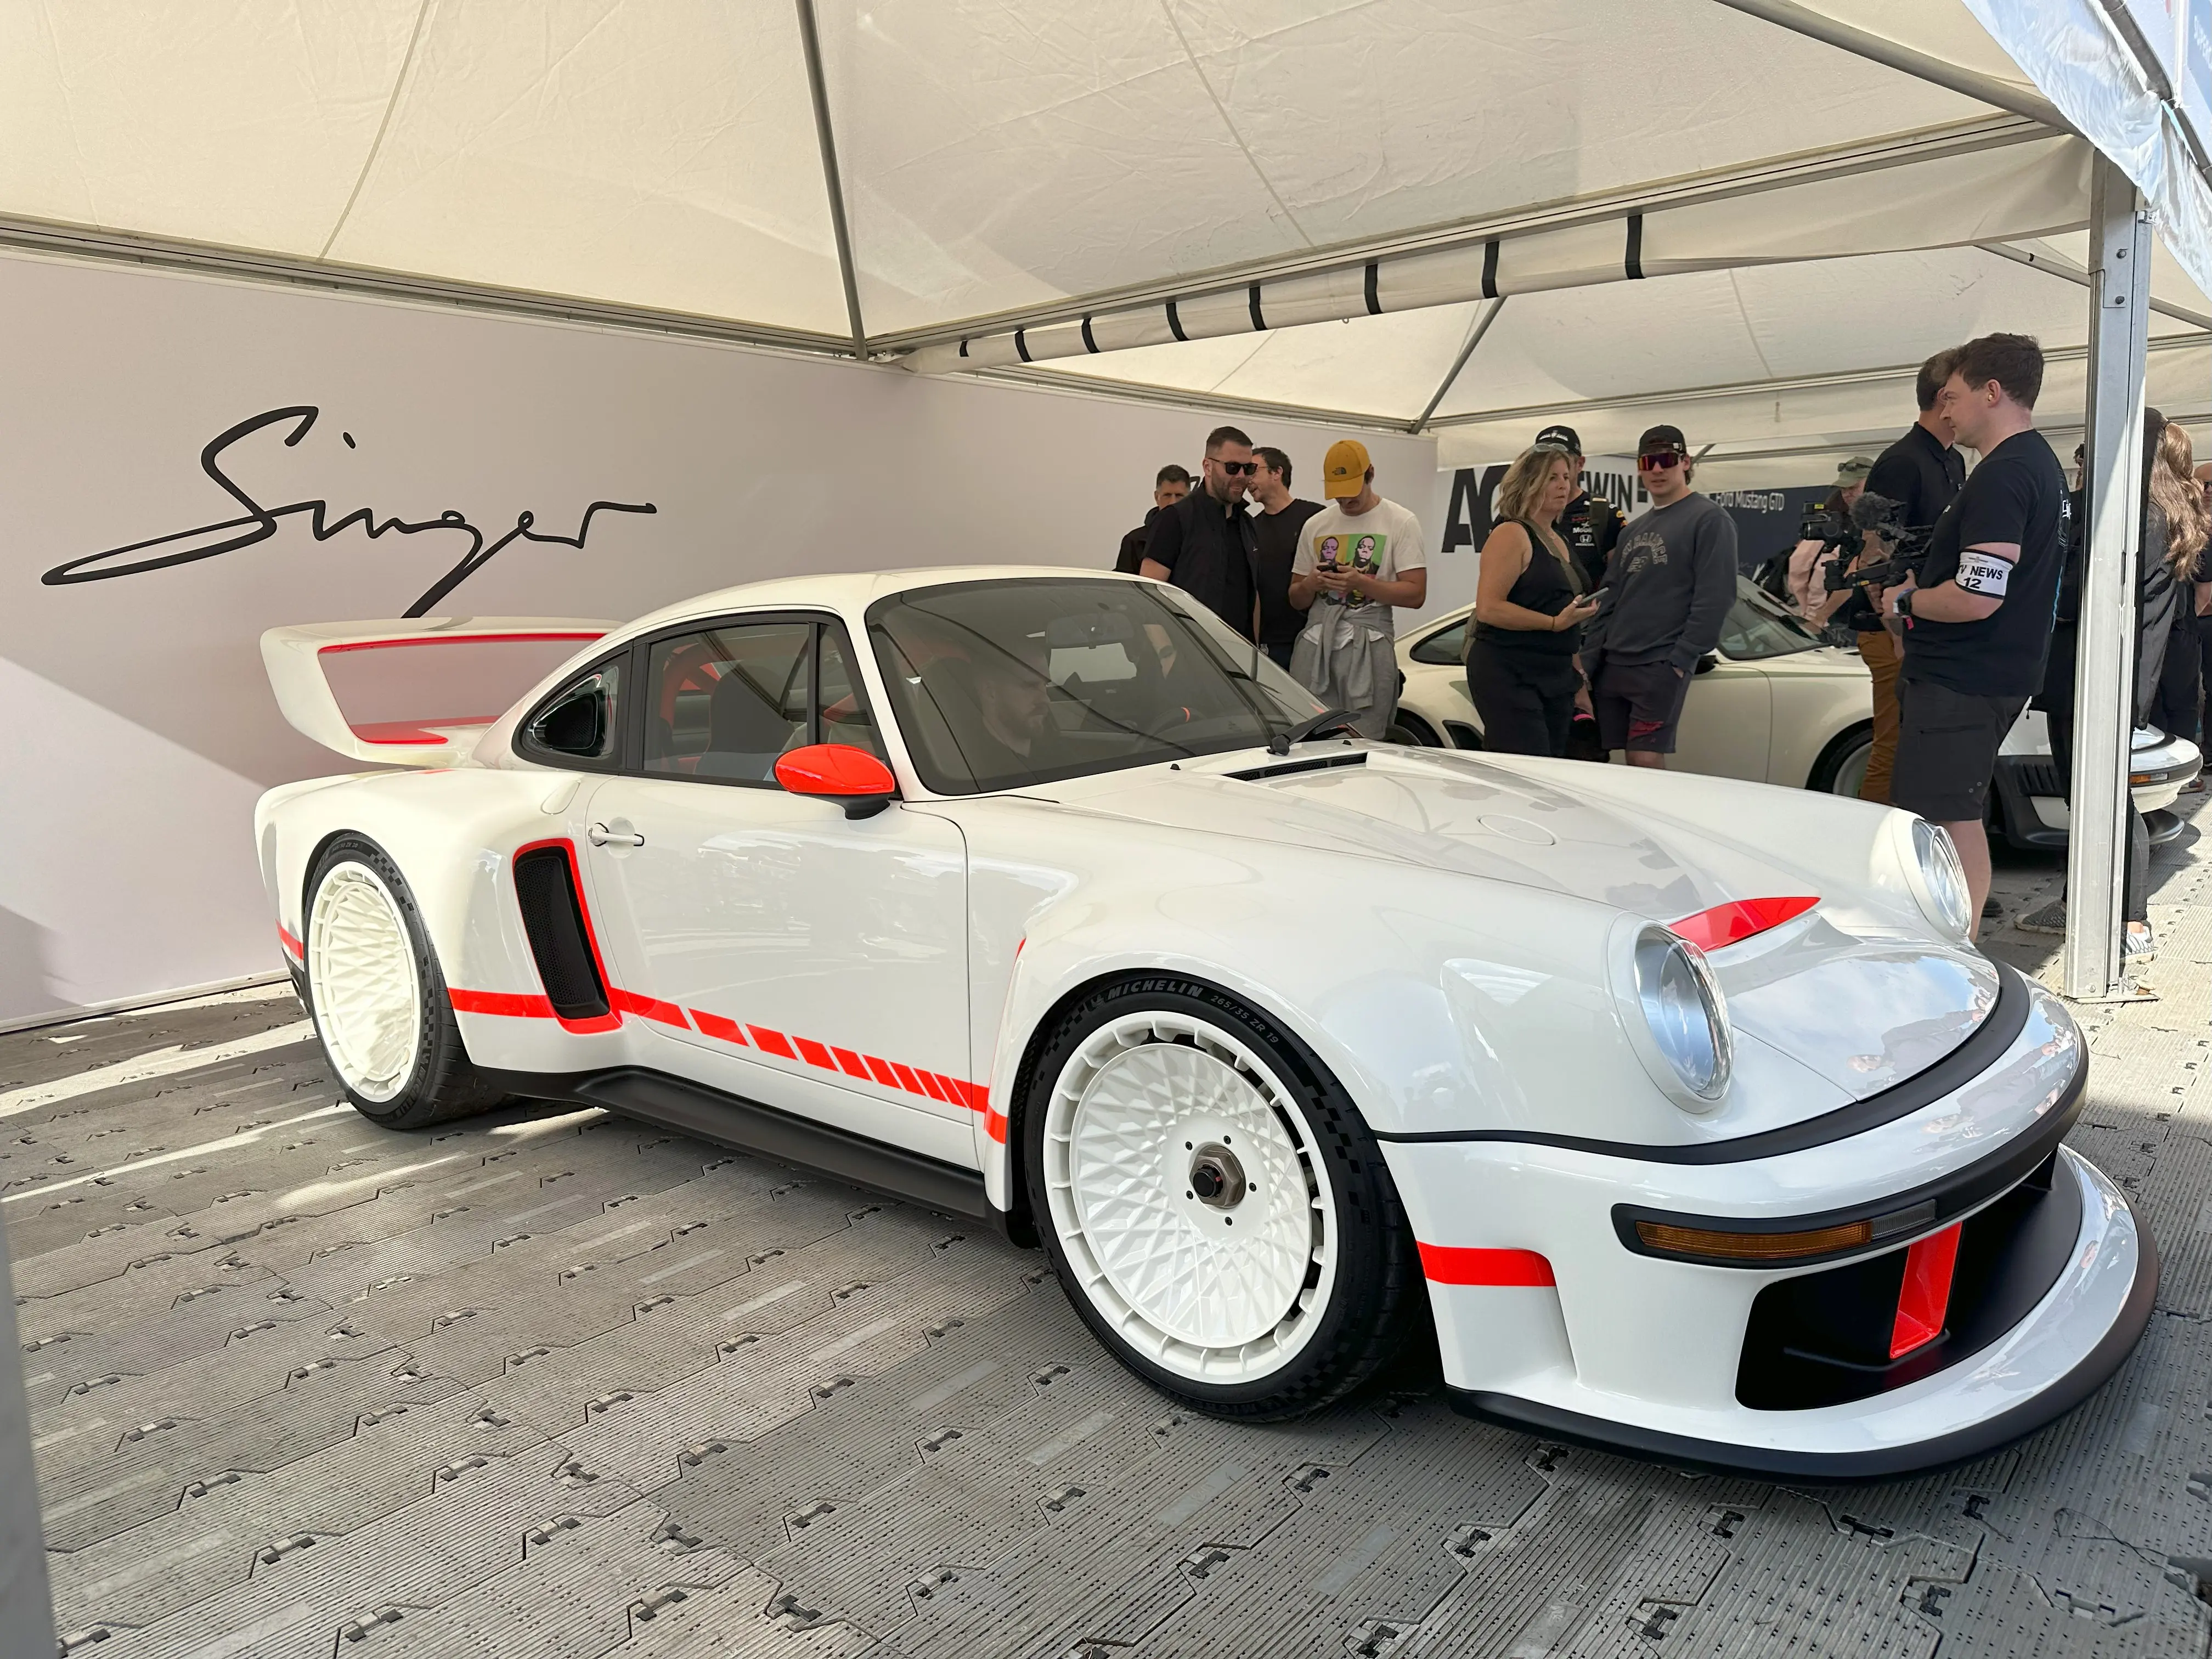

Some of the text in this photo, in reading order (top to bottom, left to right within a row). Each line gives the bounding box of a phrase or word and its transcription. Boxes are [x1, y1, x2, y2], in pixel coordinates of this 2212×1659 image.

[42, 405, 657, 618] Singer
[1716, 491, 1785, 514] Ford Mustang GTD
[1963, 577, 1982, 589] 12
[1970, 566, 2003, 580] NEWS
[1108, 980, 1279, 1043] MICHELIN 265/35 ZR 19
